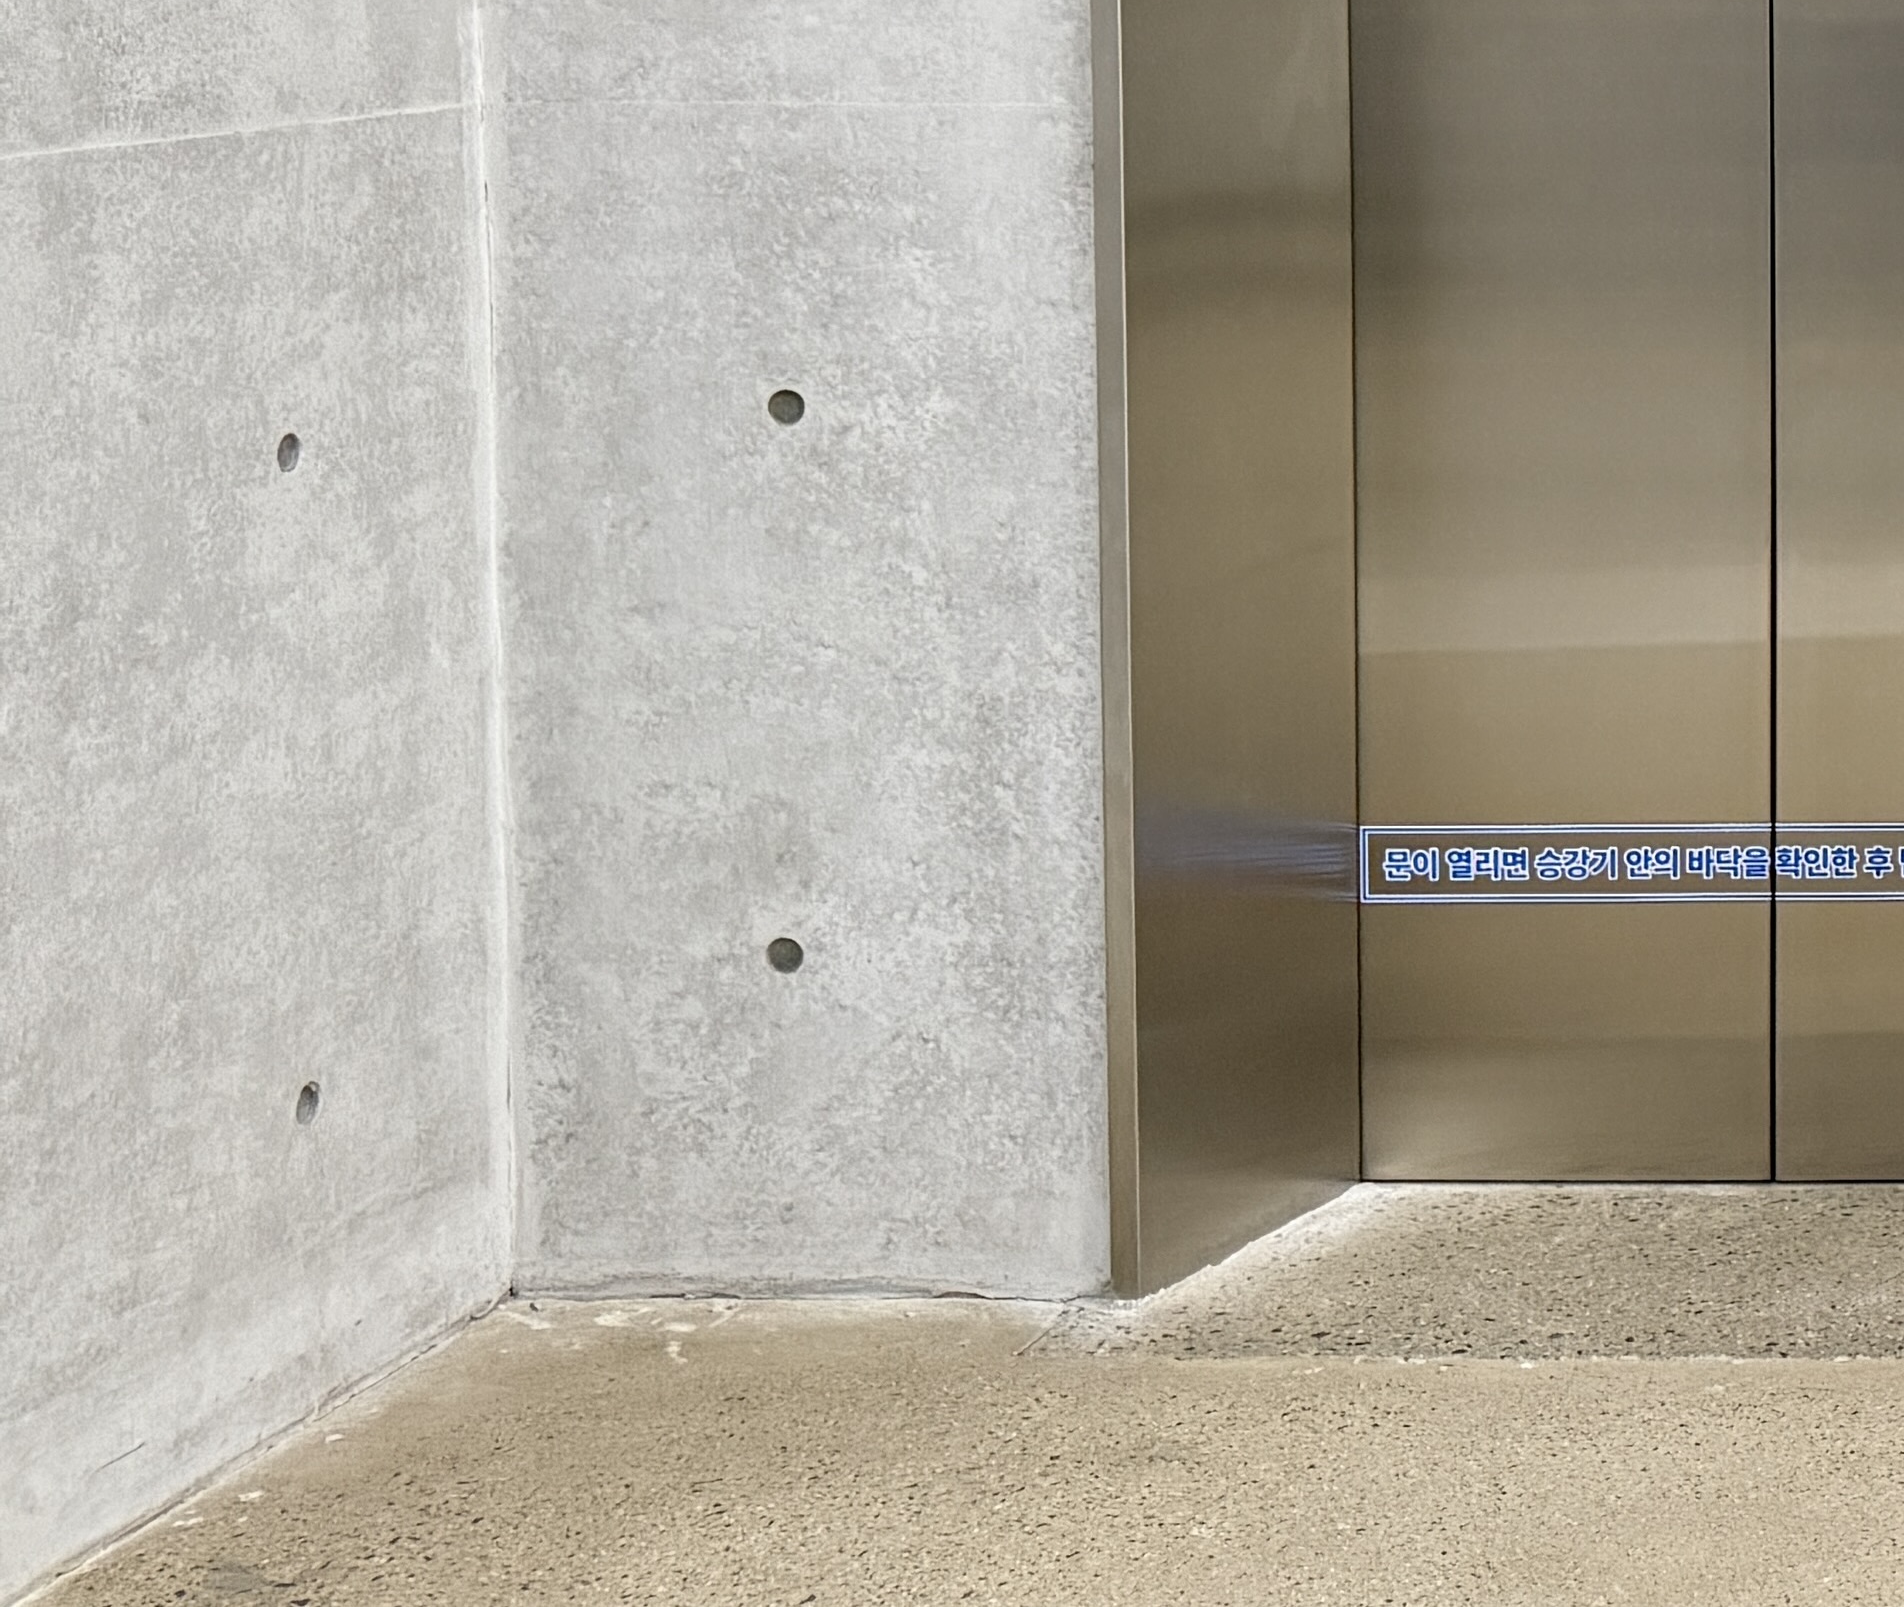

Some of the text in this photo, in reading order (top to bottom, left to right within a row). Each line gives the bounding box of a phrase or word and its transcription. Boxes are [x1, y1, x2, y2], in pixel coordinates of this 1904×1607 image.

[1382, 846, 1440, 881] 문이
[1446, 846, 1529, 881] 열리면
[1534, 846, 1619, 881] 승강기
[1625, 846, 1681, 881] 안의
[1685, 846, 1771, 881] 바닥을
[1775, 845, 1858, 879] 확인한
[1864, 845, 1893, 880] 후
